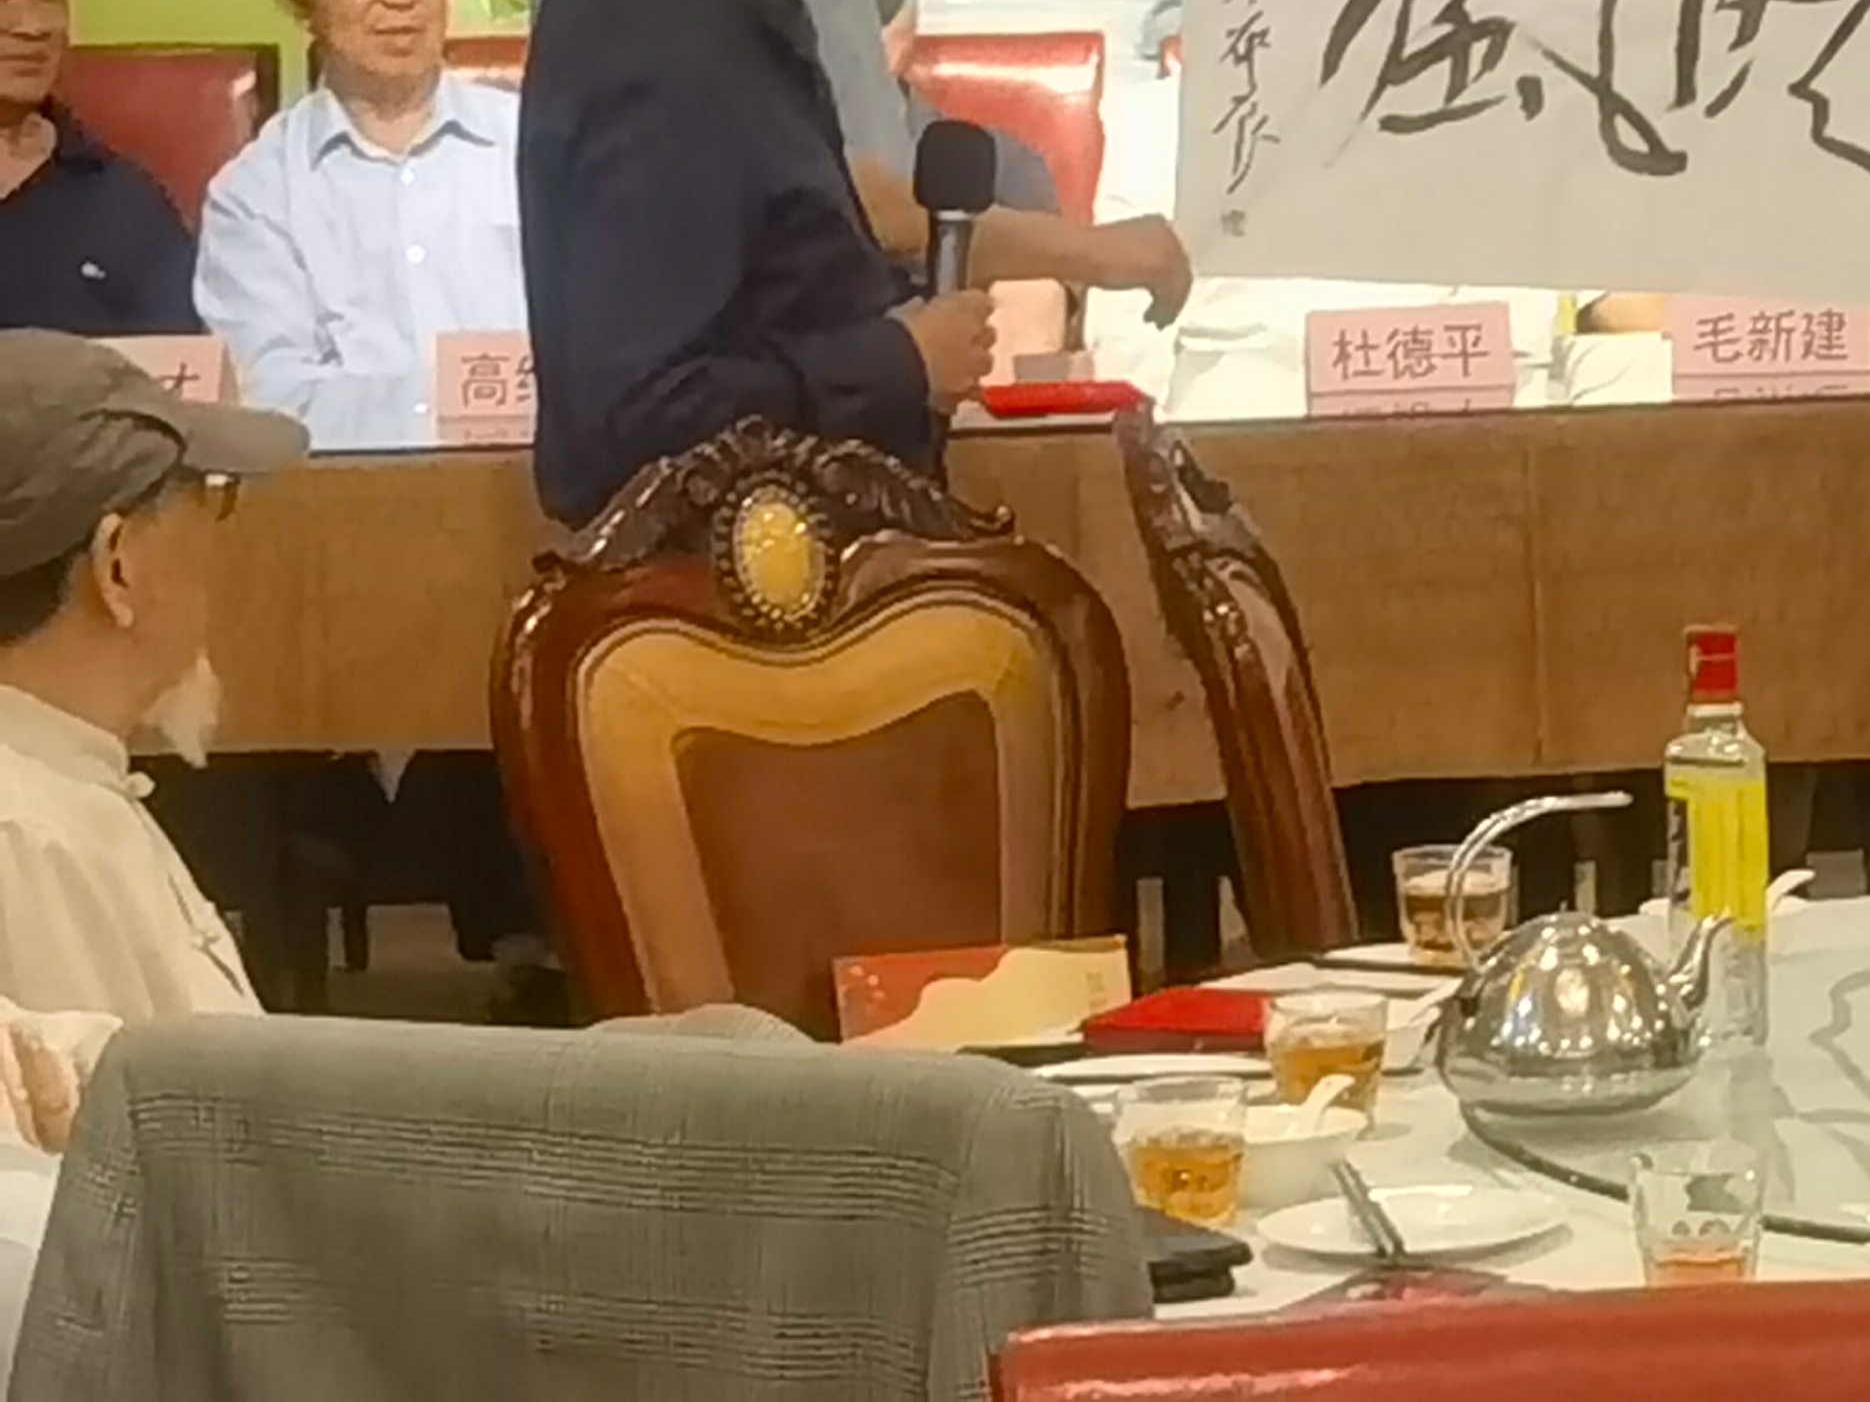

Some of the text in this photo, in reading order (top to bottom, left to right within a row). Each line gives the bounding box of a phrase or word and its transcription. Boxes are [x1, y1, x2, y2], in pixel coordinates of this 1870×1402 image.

[1331, 323, 1491, 381] 杜德平
[1692, 307, 1849, 364] 毛新建
